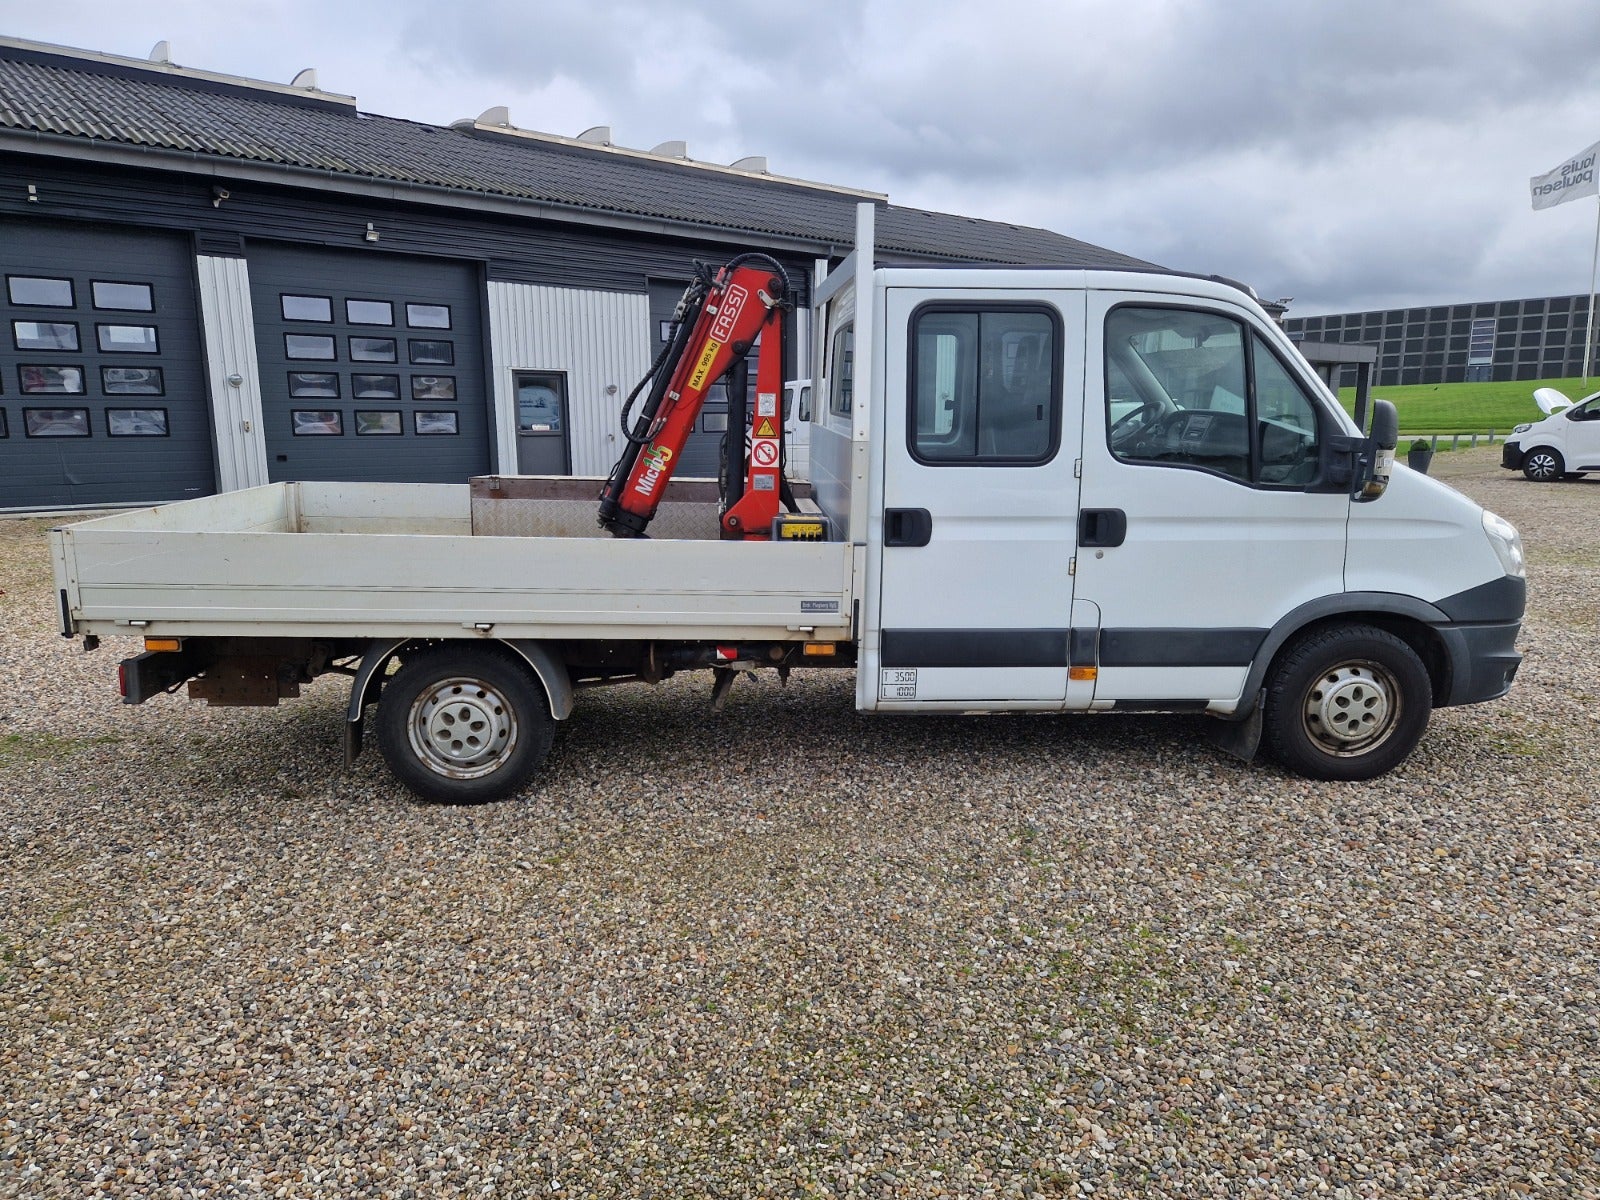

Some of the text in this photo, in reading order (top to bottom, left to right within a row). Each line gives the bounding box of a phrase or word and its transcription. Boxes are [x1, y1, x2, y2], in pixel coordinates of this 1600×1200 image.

[714, 289, 744, 338] FASSI
[701, 353, 712, 367] 995
[708, 342, 718, 353] kg
[634, 456, 665, 497] Micro
[895, 671, 915, 682] 3500
[896, 686, 915, 697] 1000
